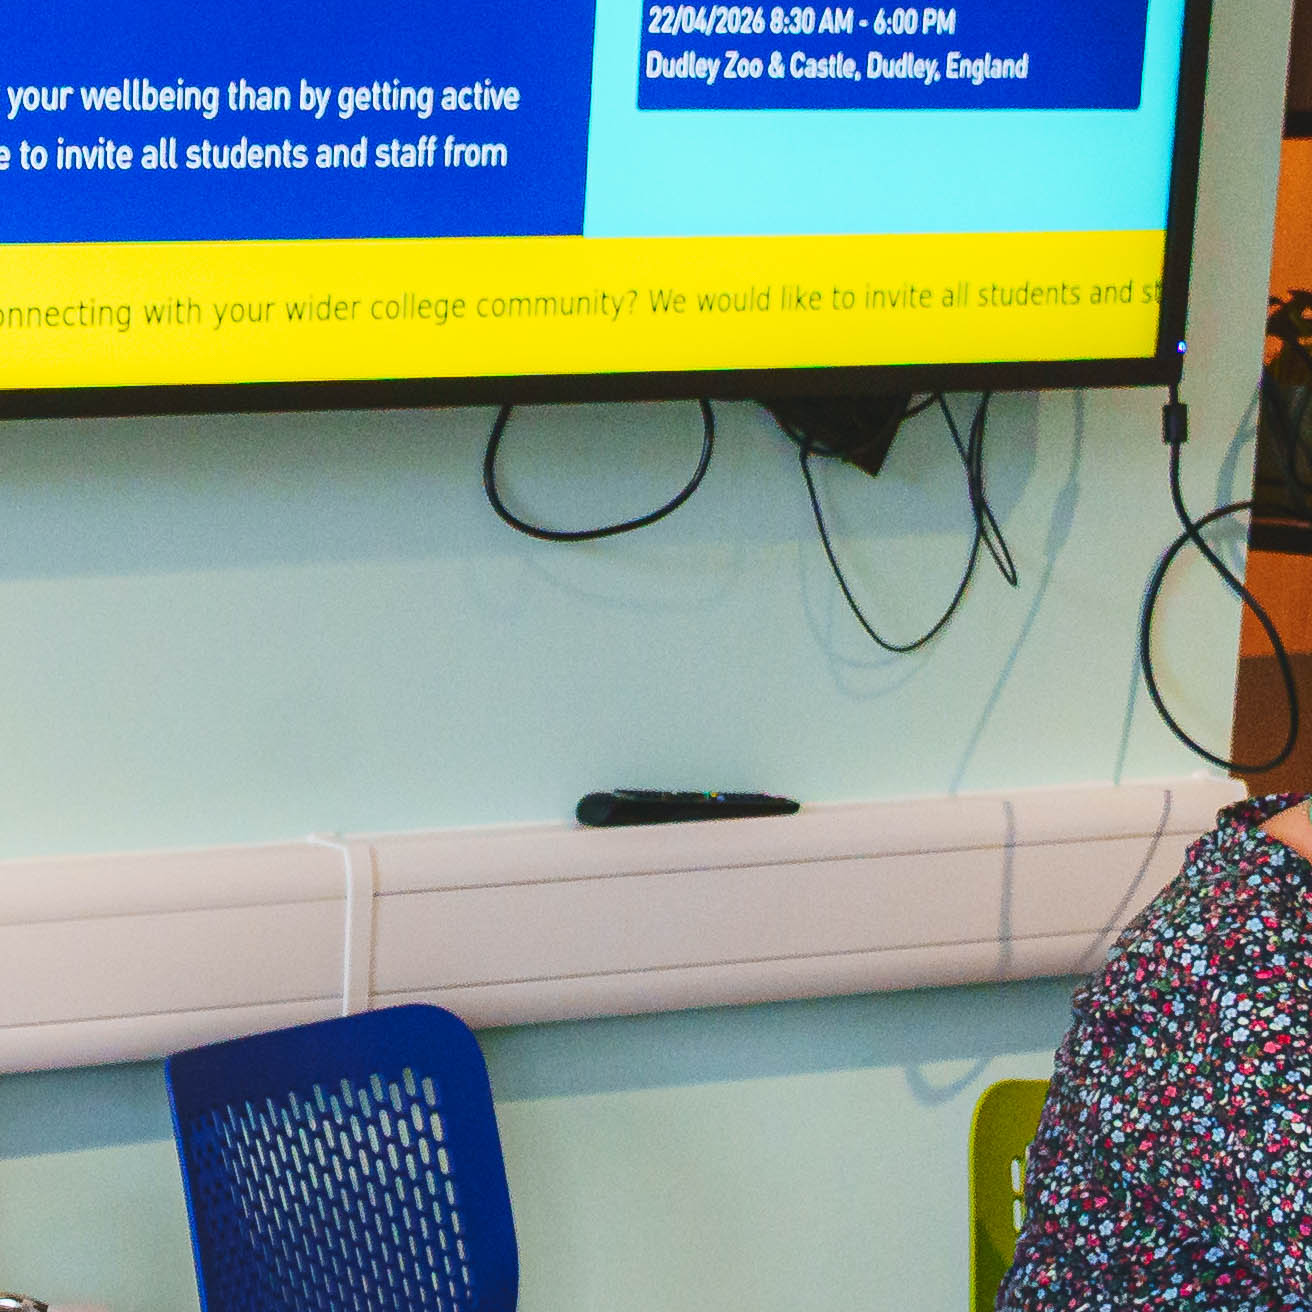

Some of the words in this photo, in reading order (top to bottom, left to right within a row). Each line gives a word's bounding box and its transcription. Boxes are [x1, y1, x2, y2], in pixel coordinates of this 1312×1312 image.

[649, 5, 765, 35] 22/04/2026
[770, 7, 815, 33] 8:30
[818, 7, 853, 33] AM
[874, 8, 918, 34] 6:00
[923, 8, 955, 34] PM
[646, 50, 720, 84] Dudley
[724, 51, 763, 78] Zoo
[768, 51, 784, 78] &
[790, 52, 861, 80] Castle,
[867, 52, 940, 85] Dudley,
[946, 52, 1029, 85] England
[8, 87, 73, 119] your
[81, 79, 219, 119] wellbeing
[229, 79, 290, 110] than
[300, 79, 331, 119] by
[338, 79, 433, 119] getting
[441, 79, 519, 110] active
[20, 141, 47, 170] to
[57, 137, 133, 169] invite
[142, 137, 177, 169] all
[186, 137, 308, 169] students
[316, 137, 367, 168] and
[375, 136, 436, 167] staff
[444, 136, 507, 167] from
[144, 298, 200, 324] with
[214, 303, 274, 330] your
[286, 295, 360, 321] wider
[371, 294, 465, 325] college
[477, 290, 637, 320] community?
[650, 289, 685, 313] We
[698, 287, 770, 312] would
[782, 286, 821, 310] like
[833, 288, 855, 310] to
[866, 286, 931, 308] invite
[942, 283, 968, 307] all
[979, 282, 1080, 306] students
[1090, 280, 1132, 304] and
